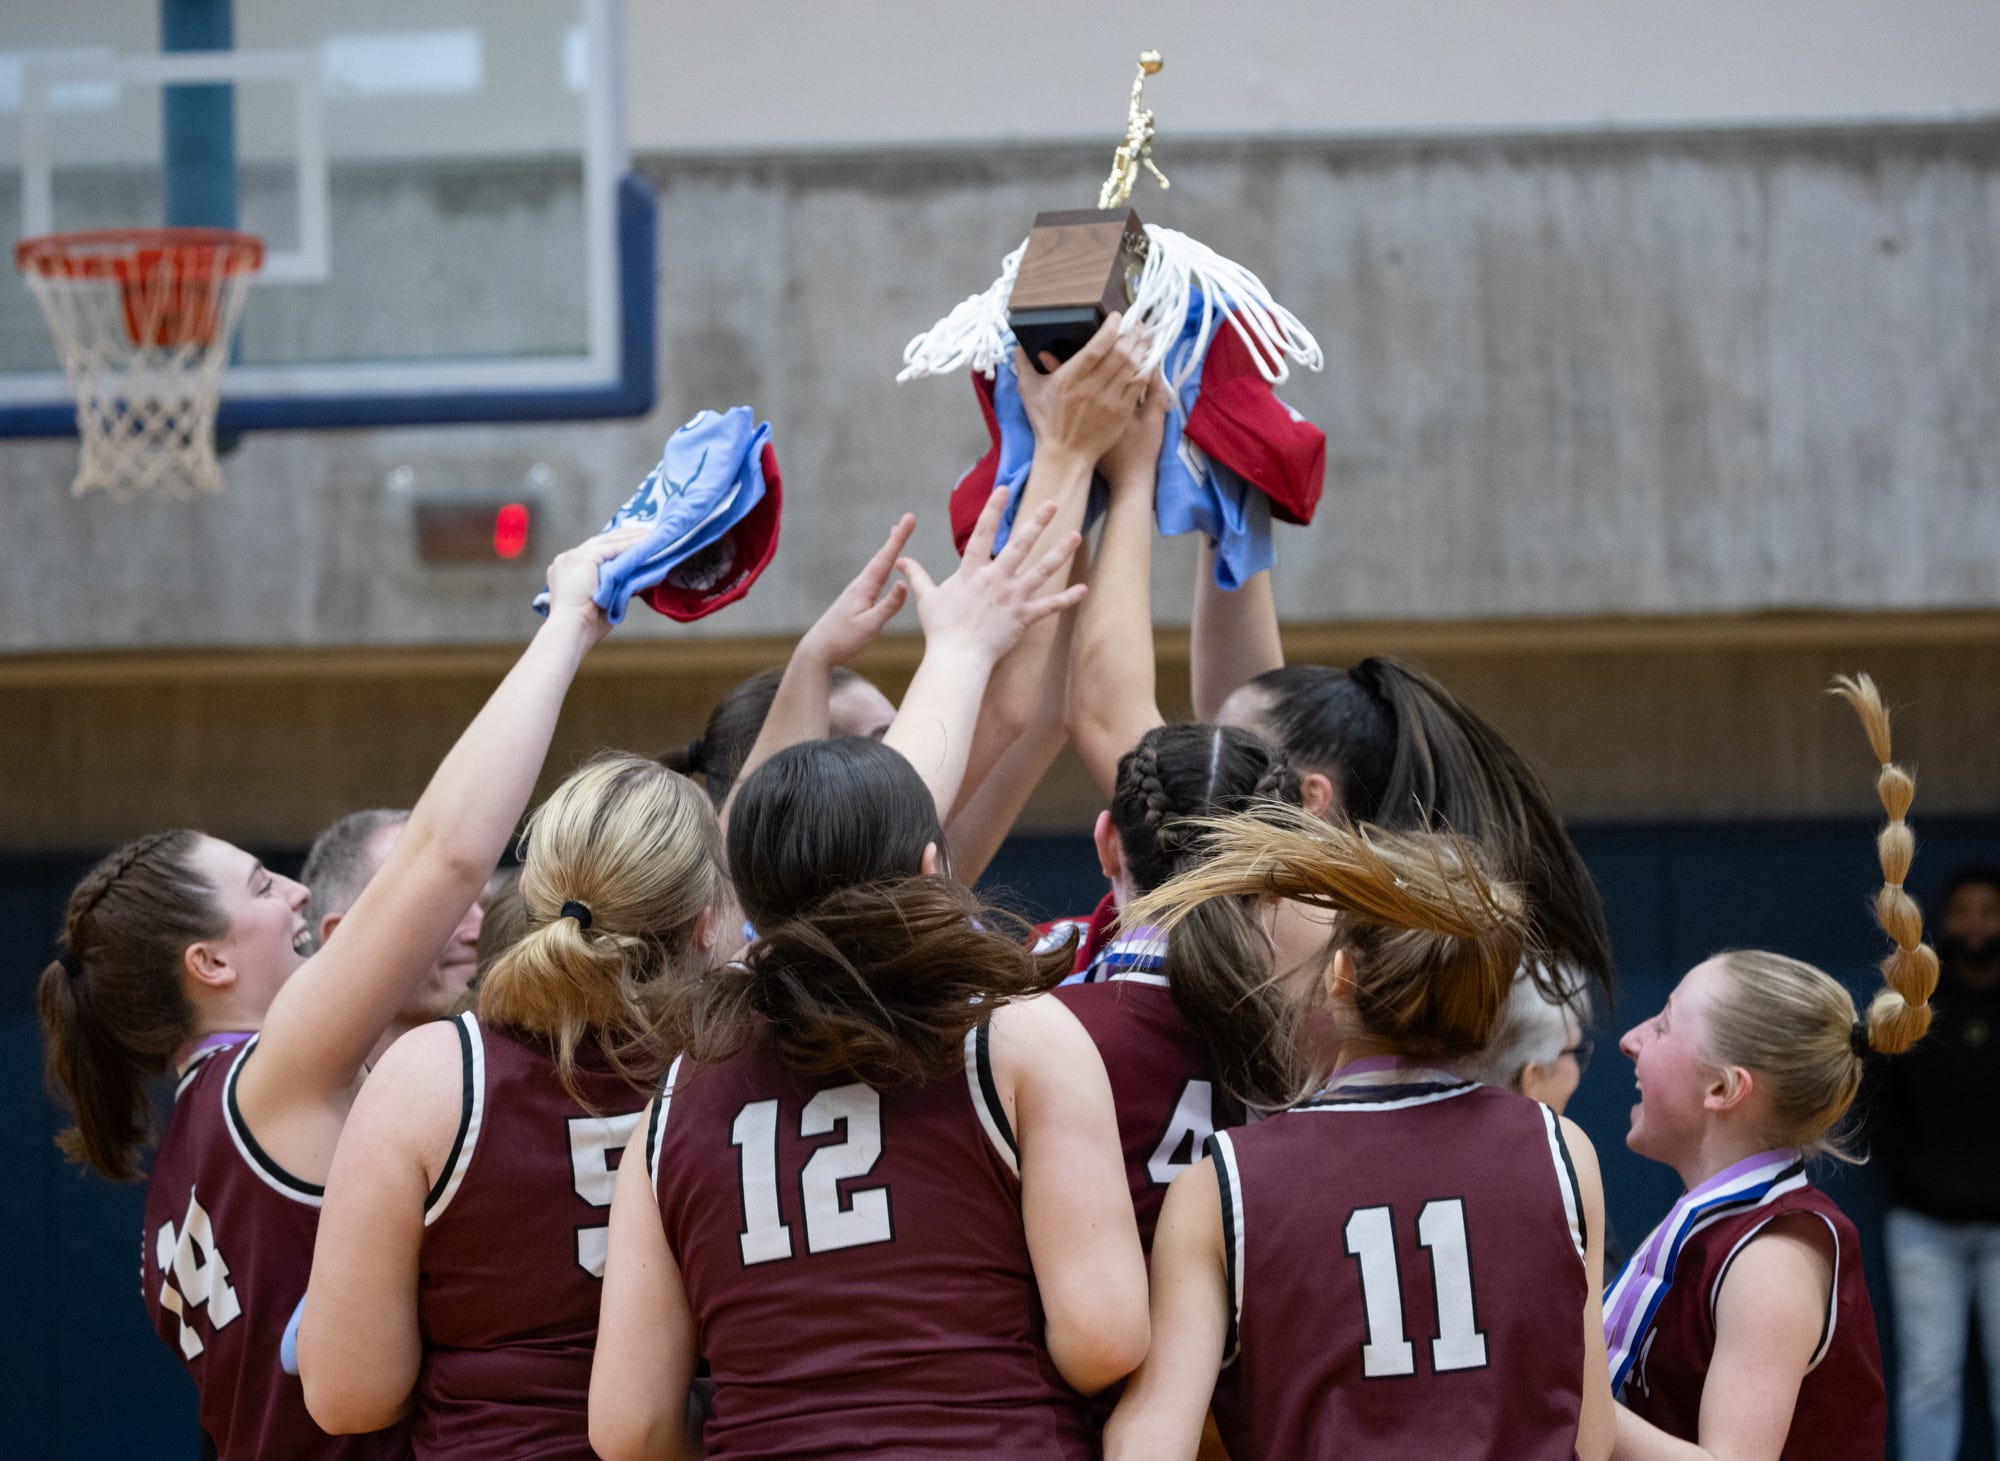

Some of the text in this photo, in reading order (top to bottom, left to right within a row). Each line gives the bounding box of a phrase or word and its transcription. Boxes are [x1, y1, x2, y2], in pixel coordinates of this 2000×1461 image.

[731, 1082, 892, 1266] 12
[155, 1184, 243, 1361] 14
[1344, 1198, 1488, 1377] 11
